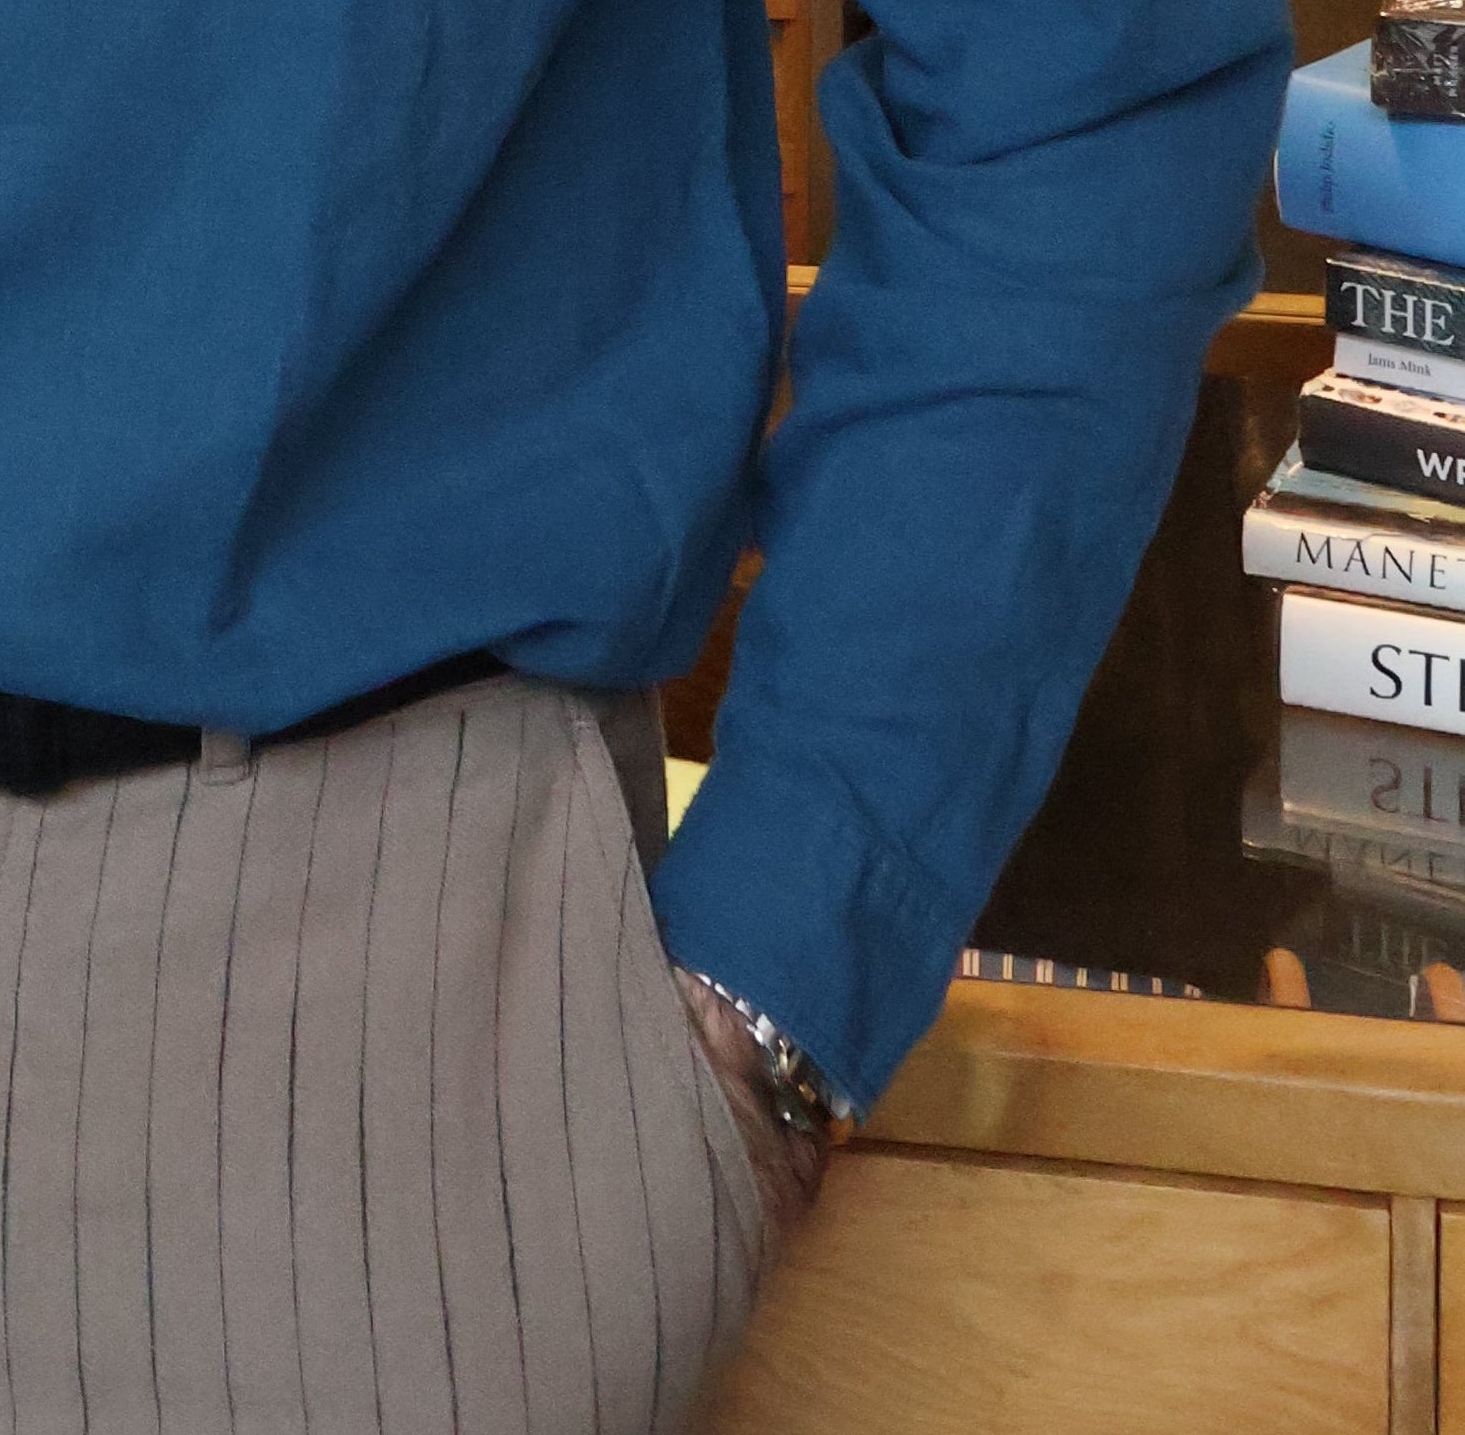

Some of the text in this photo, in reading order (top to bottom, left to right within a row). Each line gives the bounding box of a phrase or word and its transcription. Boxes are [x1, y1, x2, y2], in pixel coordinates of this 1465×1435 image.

[1340, 281, 1455, 346] THE
[1398, 360, 1432, 377] Mink
[1370, 643, 1465, 712] ST
